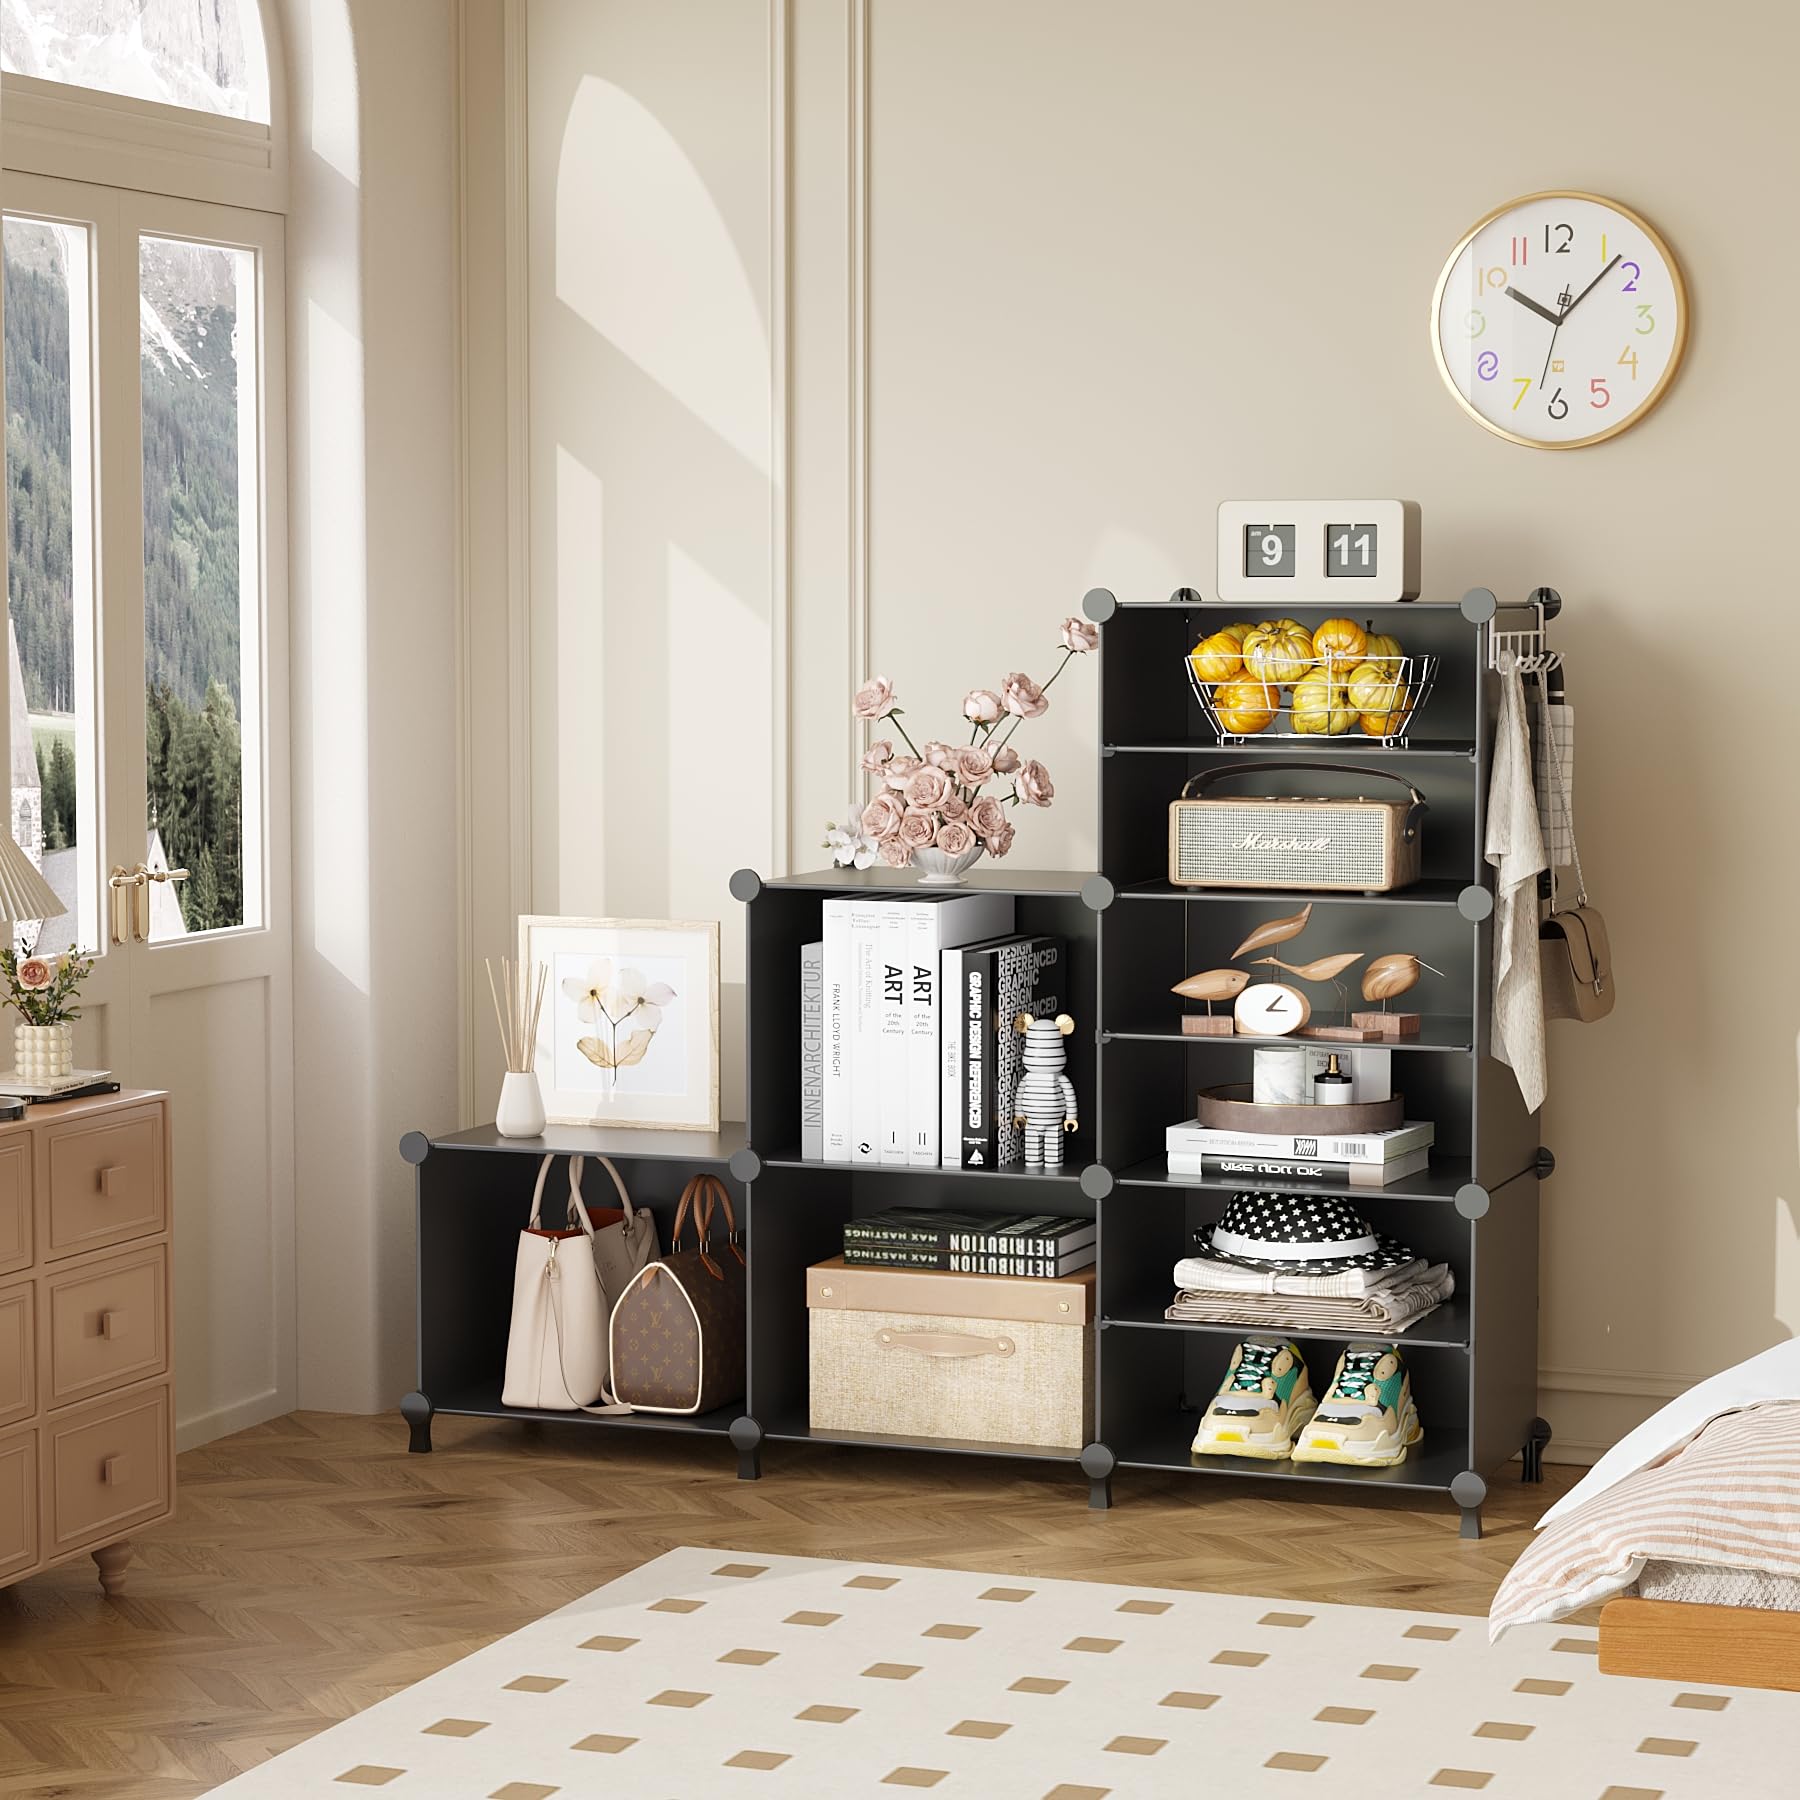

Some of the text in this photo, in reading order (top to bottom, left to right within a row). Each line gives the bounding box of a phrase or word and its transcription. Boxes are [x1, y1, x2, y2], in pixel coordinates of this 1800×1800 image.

[1512, 236, 1527, 266] 11
[1545, 223, 1574, 253] 12
[1601, 233, 1607, 263] 1
[1479, 266, 1507, 297] 10
[1620, 261, 1640, 292] 2
[1464, 309, 1486, 339] 9
[1635, 304, 1655, 335] 3
[1477, 350, 1499, 381] 8
[1617, 345, 1639, 381] 4
[1512, 378, 1532, 411] 7
[1547, 387, 1569, 420] 6
[1590, 378, 1610, 409] 5
[1261, 534, 1370, 566] 9 11
[1232, 832, 1330, 851] Marshall
[998, 943, 1033, 961] DESIGN
[998, 947, 1058, 978] REFERENCED
[884, 964, 903, 1005] ART
[913, 965, 932, 1006] ART
[968, 971, 982, 1019] GRAPHIC
[998, 968, 1040, 994] GRAPHIC
[998, 986, 1033, 1011] DESIGN
[803, 959, 822, 1128] INNENARCHITEKTUR
[832, 983, 841, 1078] FRANK LLOYD WRIGHT
[968, 1020, 982, 1059] DESIGN
[998, 1037, 1025, 1061] DESIG
[968, 1060, 982, 1129] REFERENCED
[998, 1134, 1025, 1160] DESIG
[844, 1229, 907, 1241] HASTINGS
[911, 1233, 938, 1242] MAX
[950, 1233, 1055, 1258] RETRIBUTION
[844, 1249, 907, 1262] HASTINGS
[911, 1254, 938, 1263] MAX
[950, 1254, 1055, 1278] RETRIBUTION
